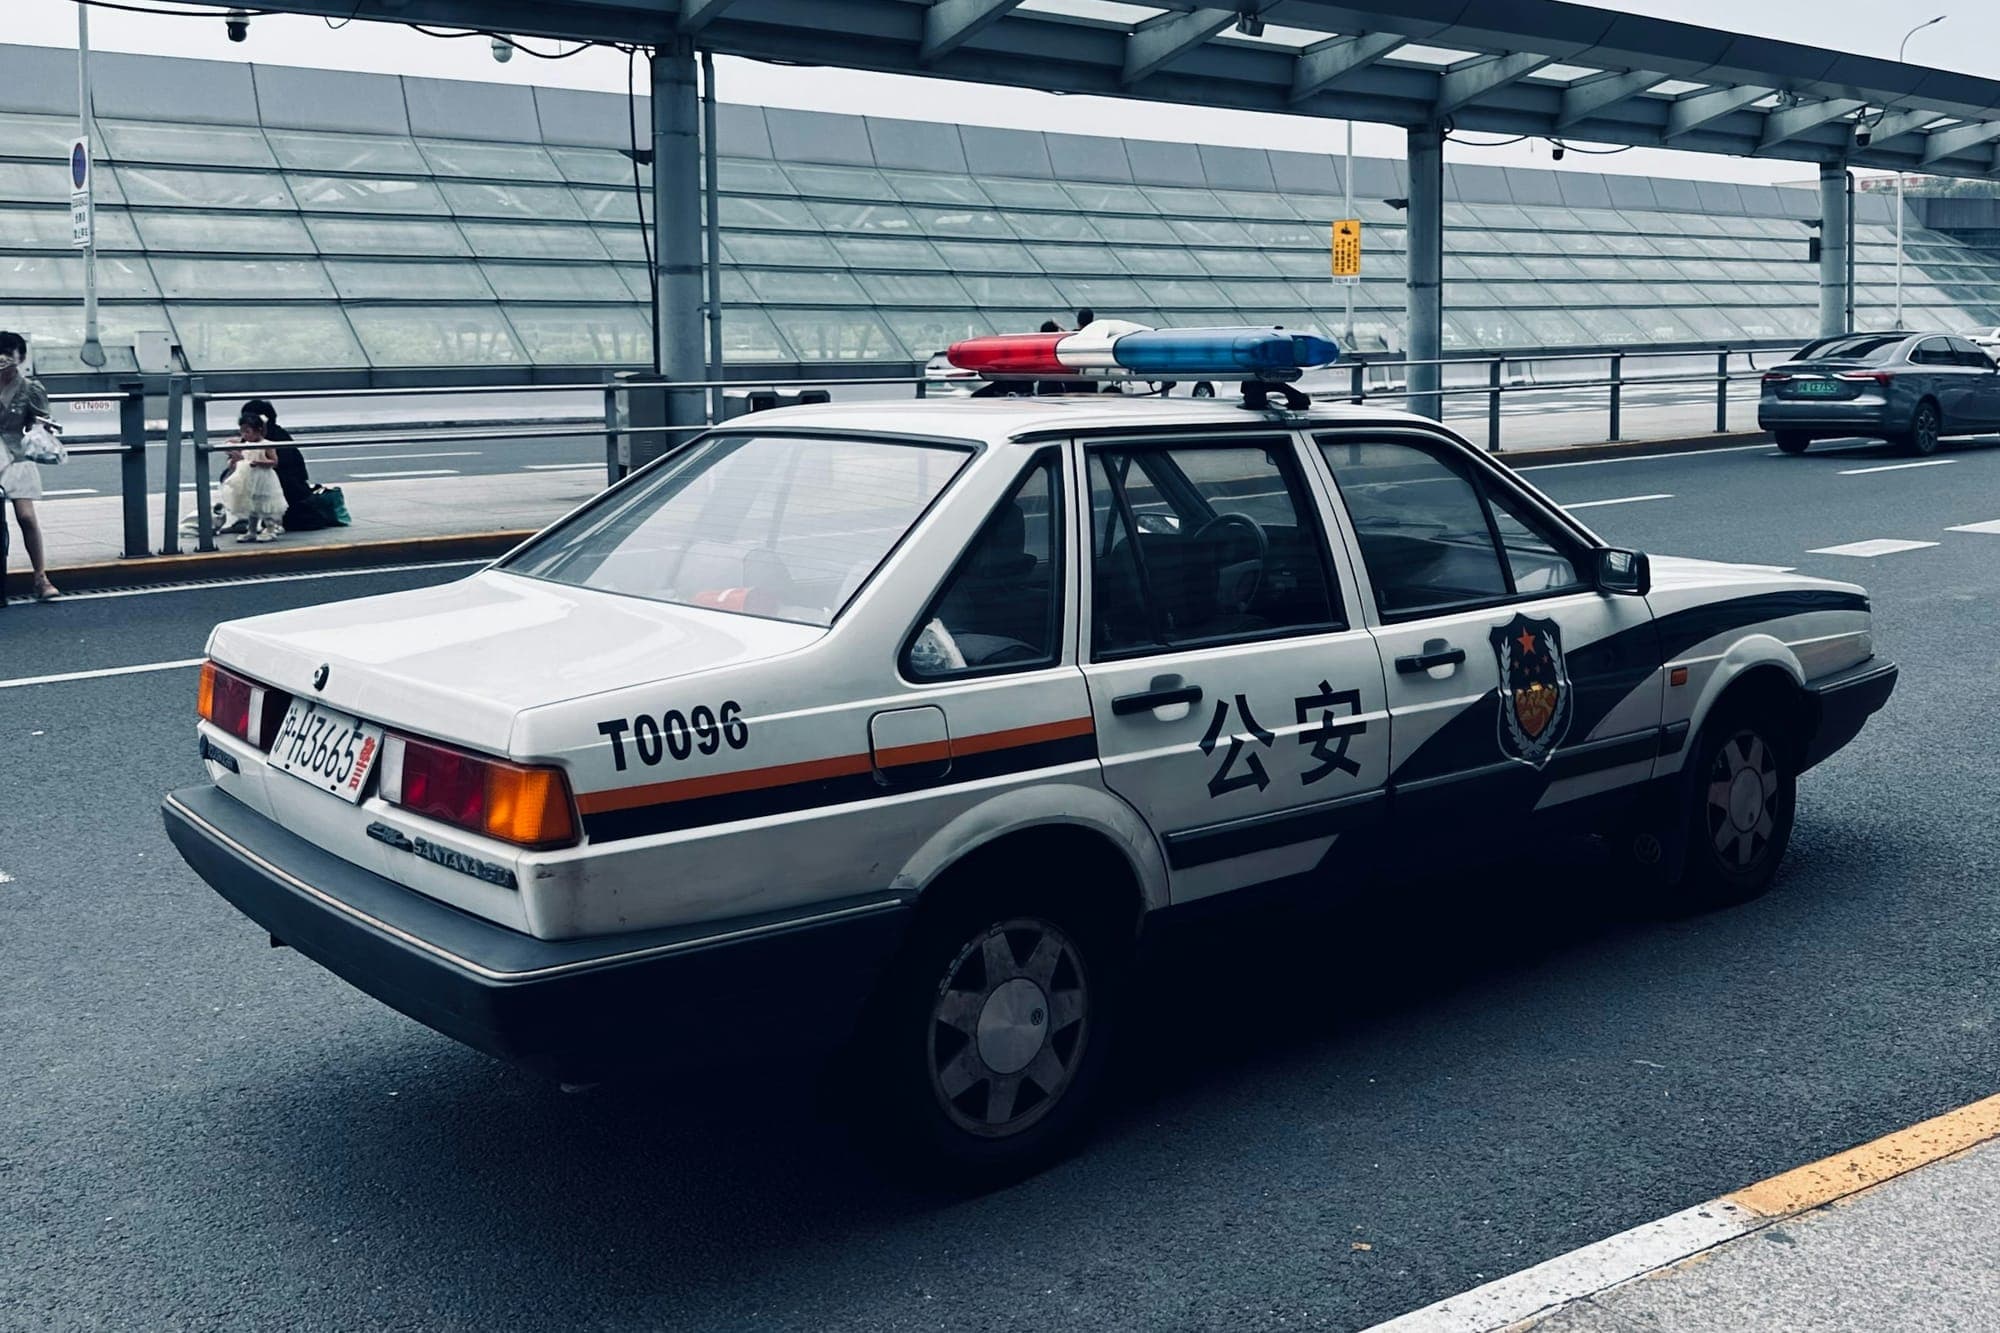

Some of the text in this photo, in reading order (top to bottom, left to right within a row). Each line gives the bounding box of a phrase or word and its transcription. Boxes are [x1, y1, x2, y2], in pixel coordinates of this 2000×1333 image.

[597, 700, 749, 771] T0096
[1199, 680, 1366, 799] 公安
[414, 836, 485, 877] SANTANA
